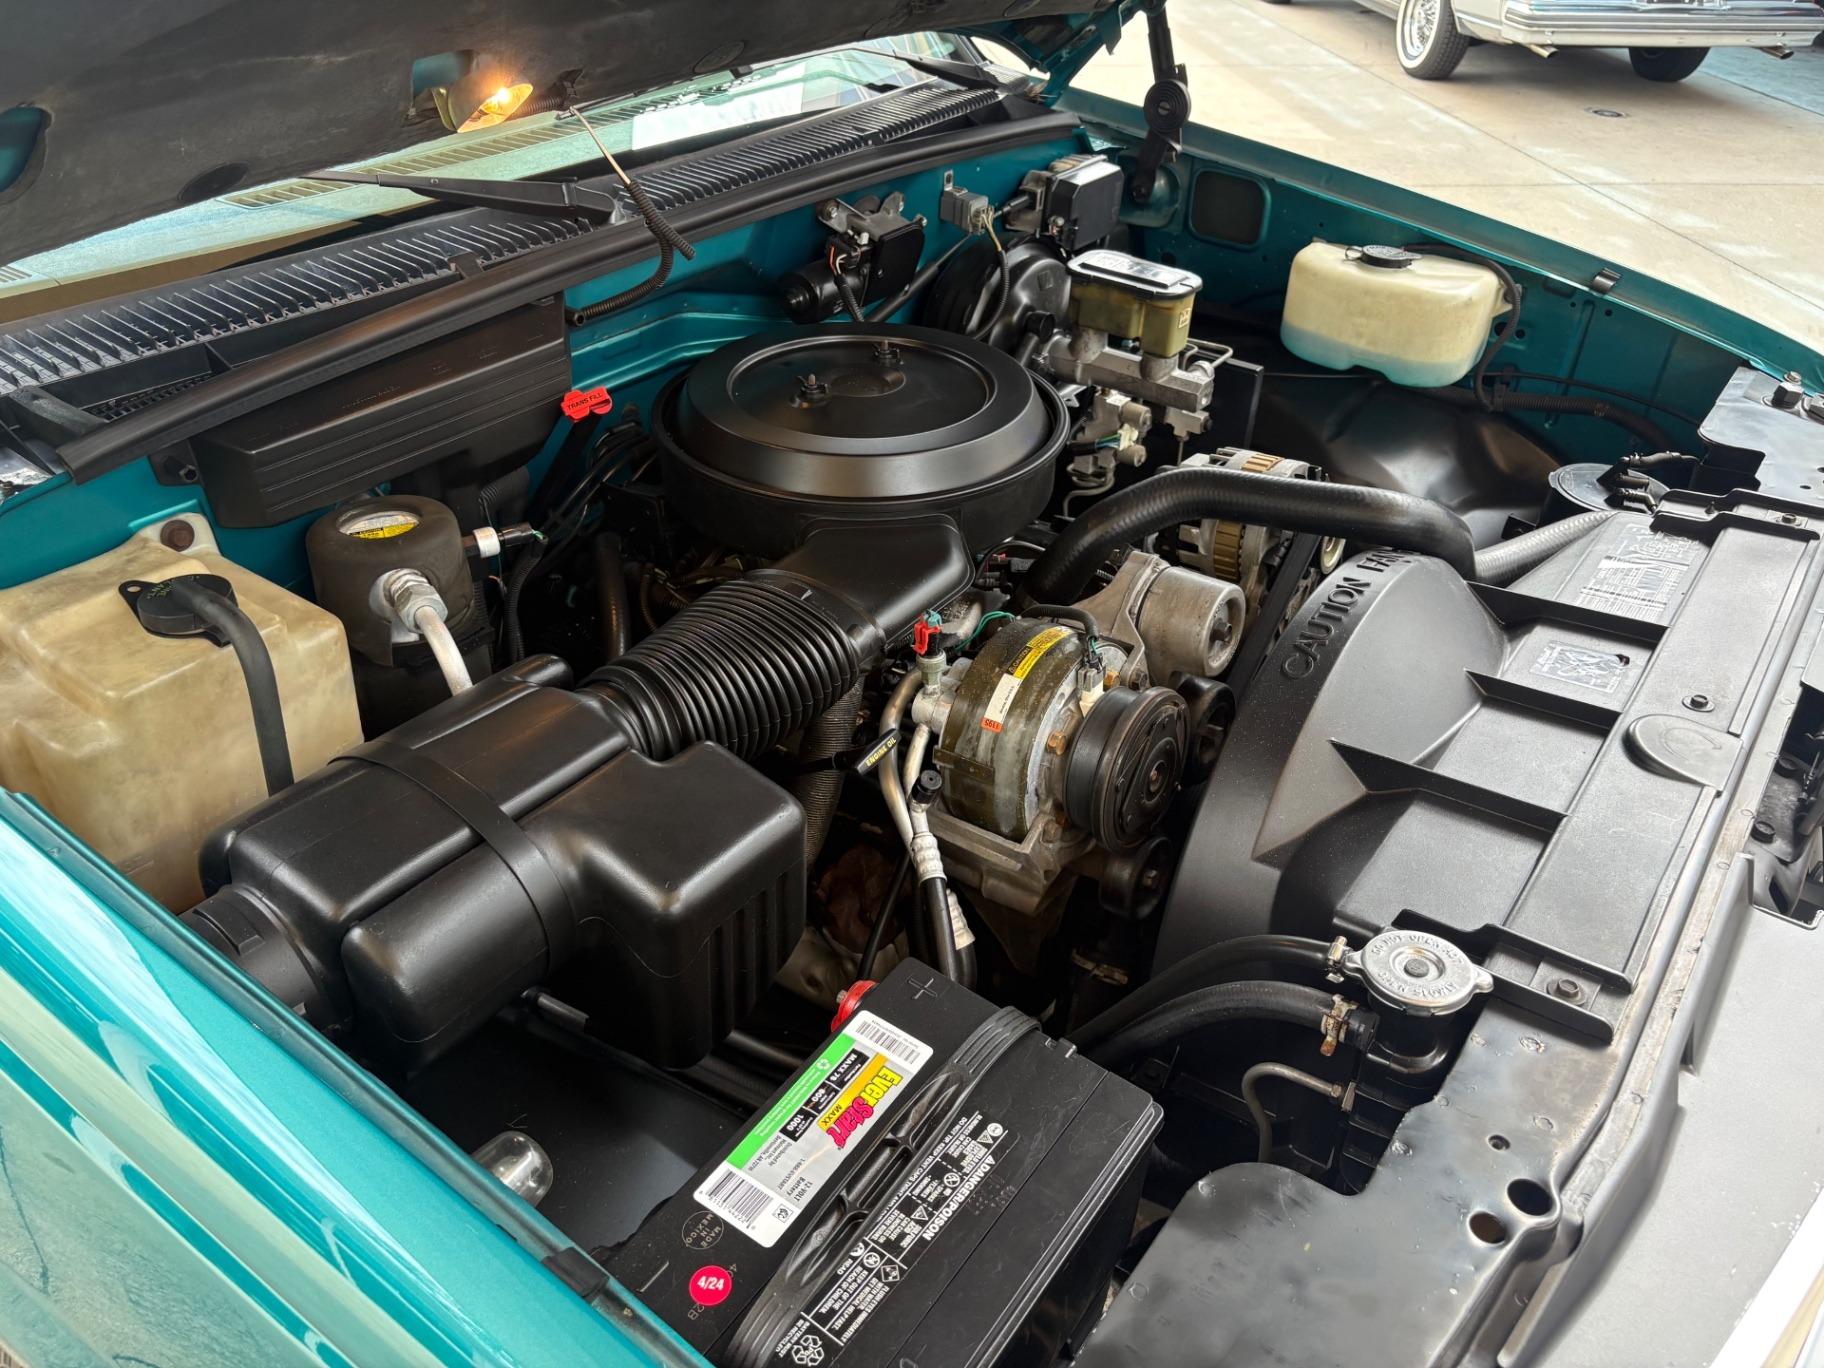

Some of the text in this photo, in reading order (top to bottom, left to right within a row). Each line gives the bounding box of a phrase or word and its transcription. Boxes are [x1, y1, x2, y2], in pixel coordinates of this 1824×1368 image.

[568, 393, 602, 410] TRANS FILL
[1283, 551, 1411, 679] CAUTION FAN
[866, 737, 897, 767] ENGINE OIL
[836, 1053, 857, 1073] MAXX
[820, 1103, 842, 1126] MAXX
[825, 1067, 903, 1149] EverStart
[785, 1113, 804, 1131] 1000
[931, 1142, 945, 1156] KEEP
[921, 1155, 934, 1168] VENT
[909, 1167, 923, 1181] CAPS
[785, 1176, 805, 1196] Battery
[792, 1180, 813, 1201] 12-VOLT
[922, 1162, 990, 1241] DANGER/POISON
[686, 1213, 714, 1244] MEXICO
[701, 1226, 721, 1248] MADE
[836, 1258, 853, 1275] READ
[845, 1265, 863, 1283] REACH
[697, 1275, 725, 1291] 4/24
[855, 1270, 869, 1283] KEEP
[867, 1277, 878, 1287] GET
[846, 1281, 858, 1293] OUT
[851, 1286, 870, 1306] MEDICAL
[870, 1281, 883, 1294] WITH
[831, 1298, 844, 1310] THE
[841, 1304, 855, 1318] HELP
[777, 1320, 810, 1357] BATTERY MUST
